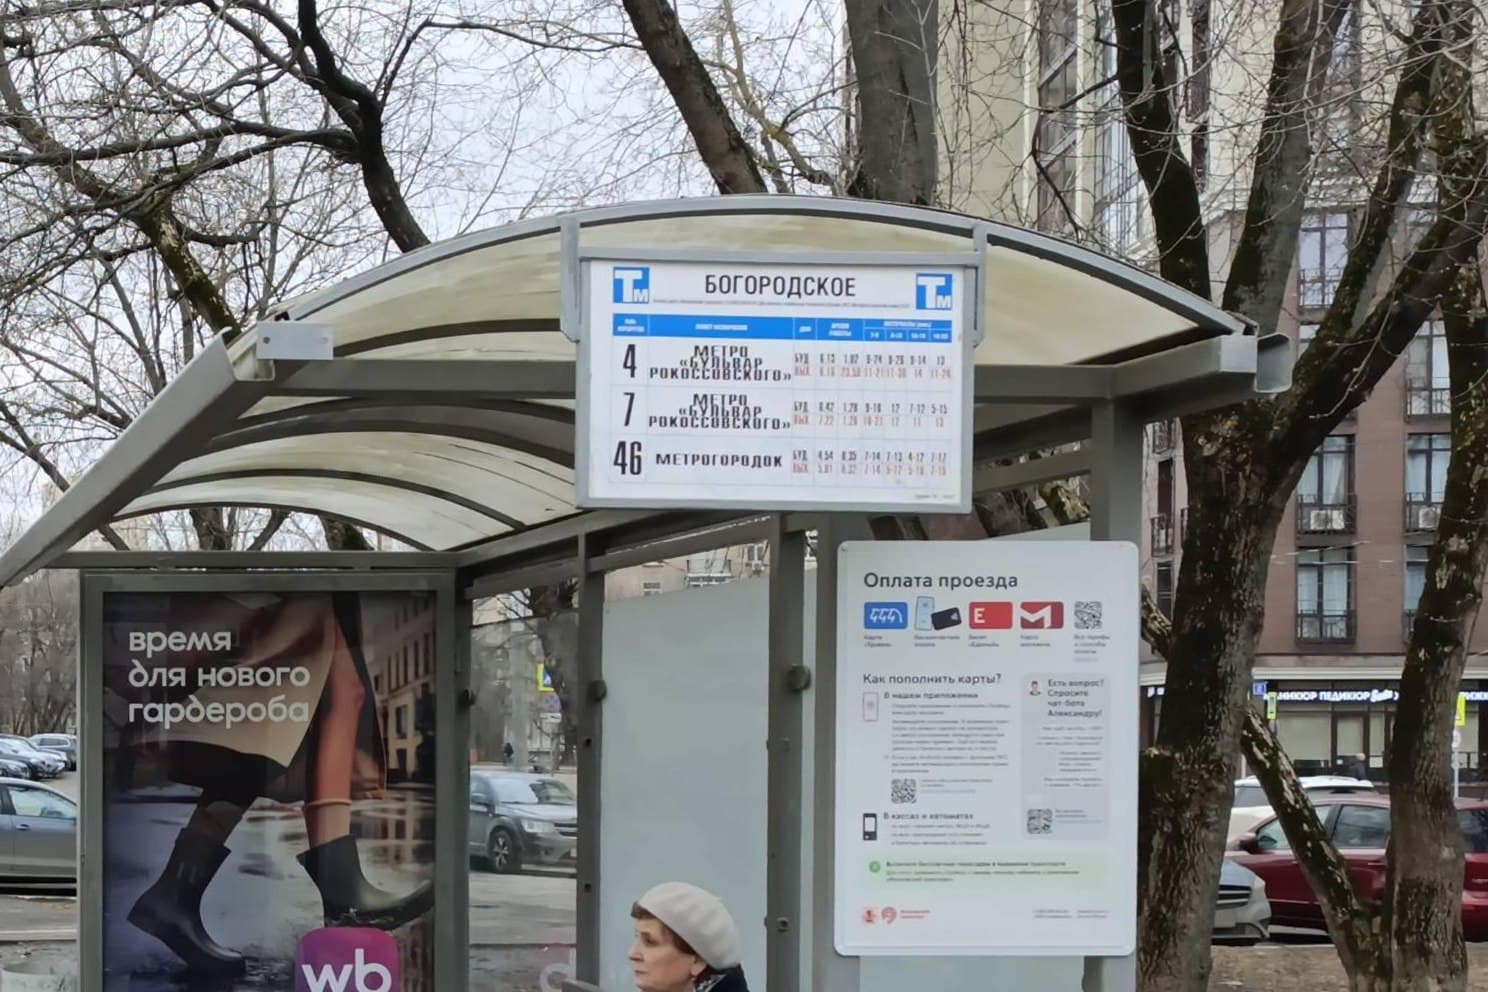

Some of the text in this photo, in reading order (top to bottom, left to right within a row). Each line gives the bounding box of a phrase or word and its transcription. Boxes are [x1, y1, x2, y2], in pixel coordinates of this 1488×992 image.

[705, 274, 857, 298] БОГОРОДСКОЕ
[623, 344, 637, 378] 4
[694, 345, 749, 358] МЕТРО
[649, 367, 792, 381] РОКОССОВСКОГО»
[623, 392, 635, 427] 7
[693, 393, 748, 406] МЕТРО
[649, 416, 791, 430] РОКОССОВСКОГО»
[613, 440, 642, 475] 46
[656, 453, 783, 468] МЕТРОГОРОДОК
[864, 572, 1018, 590] Оплата проезда
[129, 631, 231, 658] время
[128, 659, 310, 687] для нового
[863, 673, 1001, 685] Как пополнить карты?
[129, 694, 309, 729] гардероба
